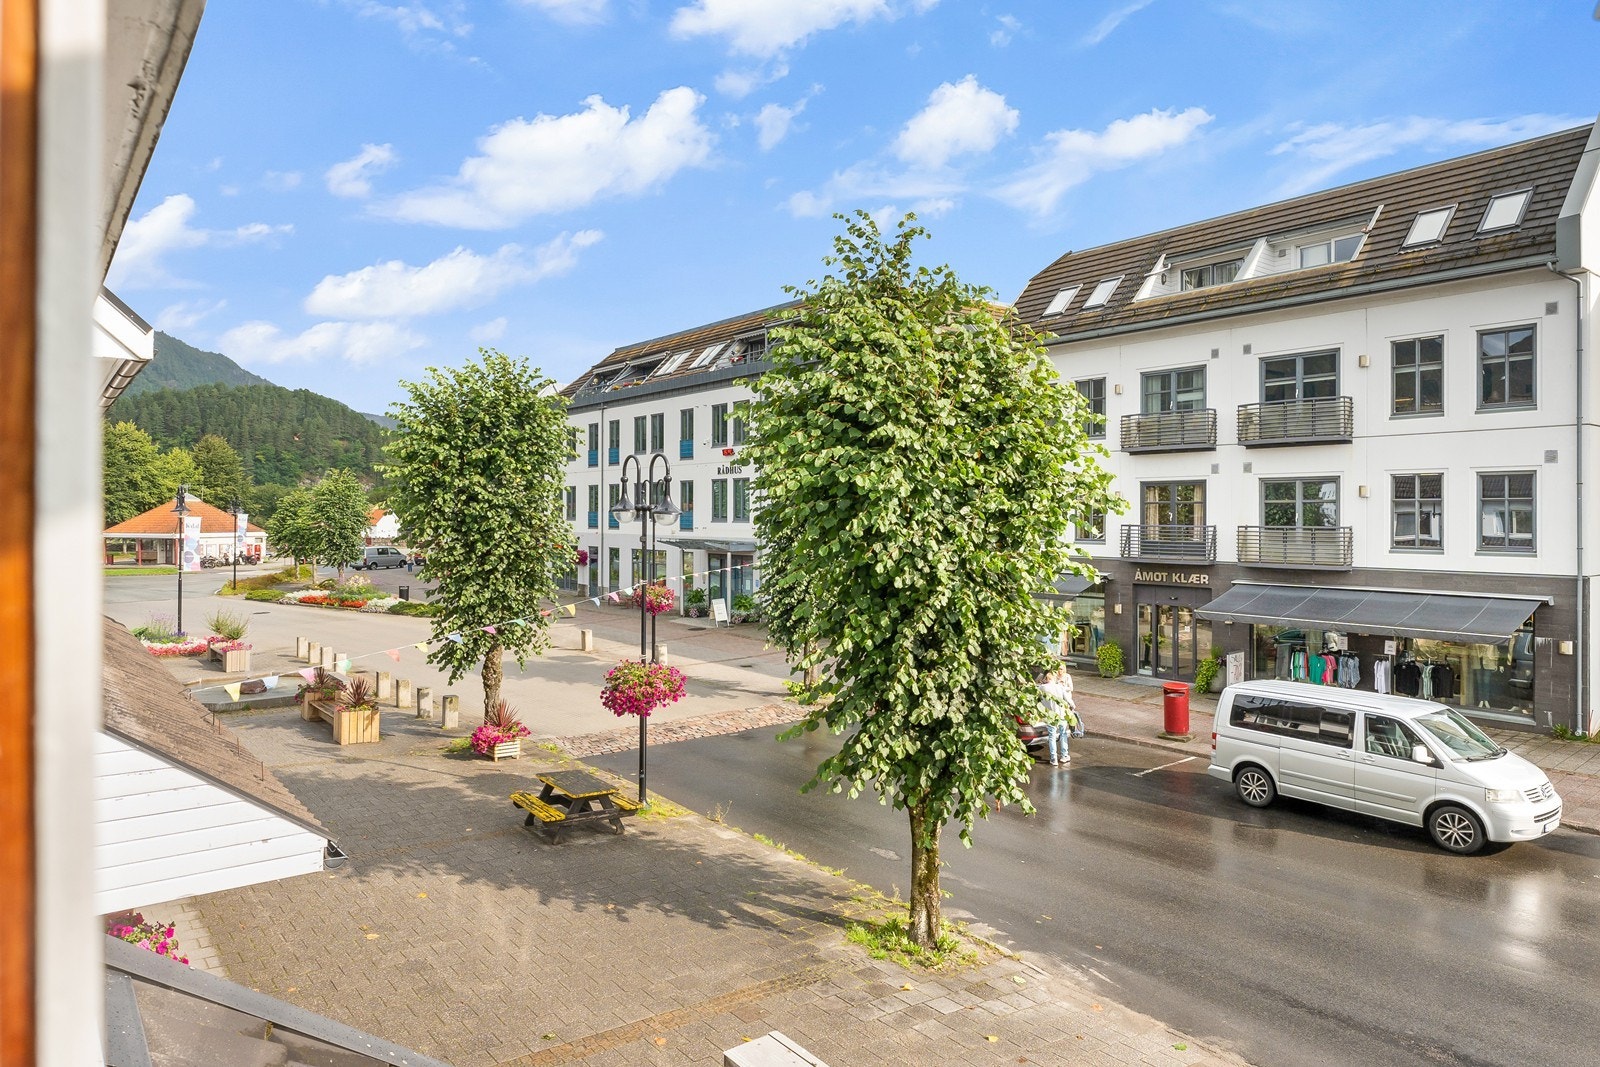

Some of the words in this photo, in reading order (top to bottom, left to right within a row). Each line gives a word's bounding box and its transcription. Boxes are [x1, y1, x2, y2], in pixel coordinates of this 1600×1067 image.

[717, 464, 743, 475] RÅDHUS
[1134, 568, 1169, 582] ÅMOT
[1172, 572, 1209, 585] KLÆR
